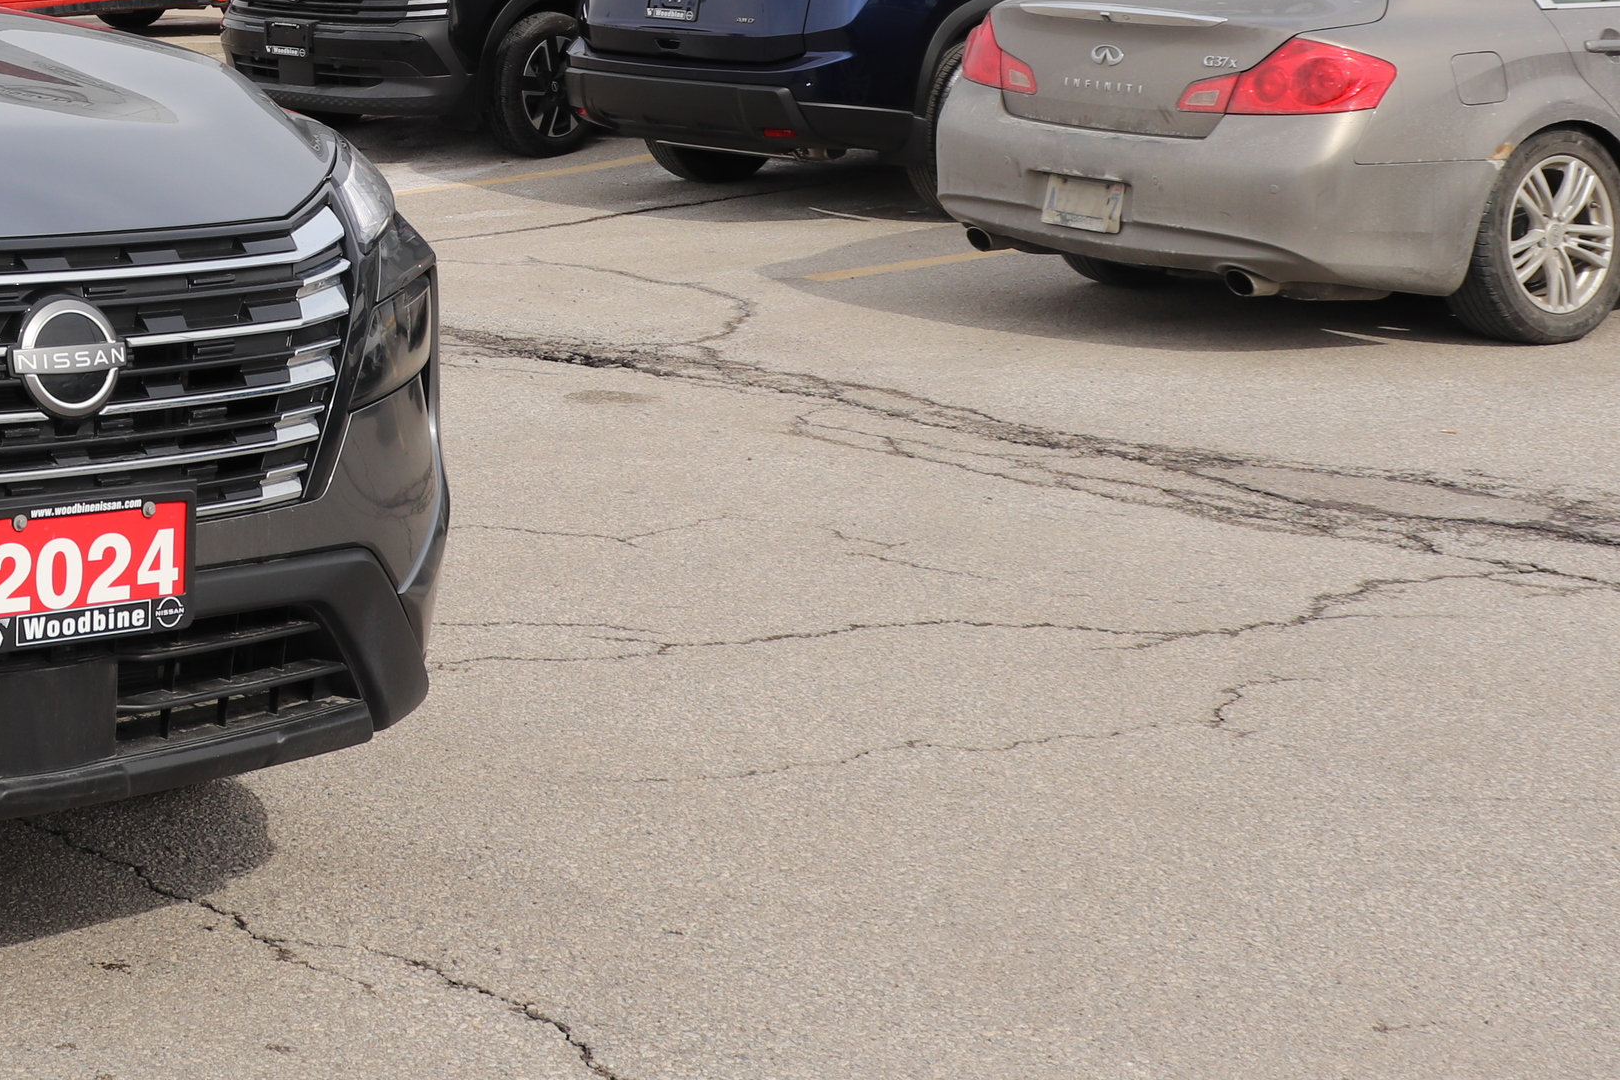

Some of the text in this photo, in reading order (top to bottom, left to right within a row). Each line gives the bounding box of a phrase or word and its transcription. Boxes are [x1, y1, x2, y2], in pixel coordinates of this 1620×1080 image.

[1202, 55, 1238, 69] G37x
[1062, 77, 1144, 94] INFINITI
[17, 345, 126, 373] NISSAN
[30, 498, 142, 519] www.woodbinenissan.com
[155, 605, 185, 618] NISSAN
[23, 605, 146, 641] Woodbine
